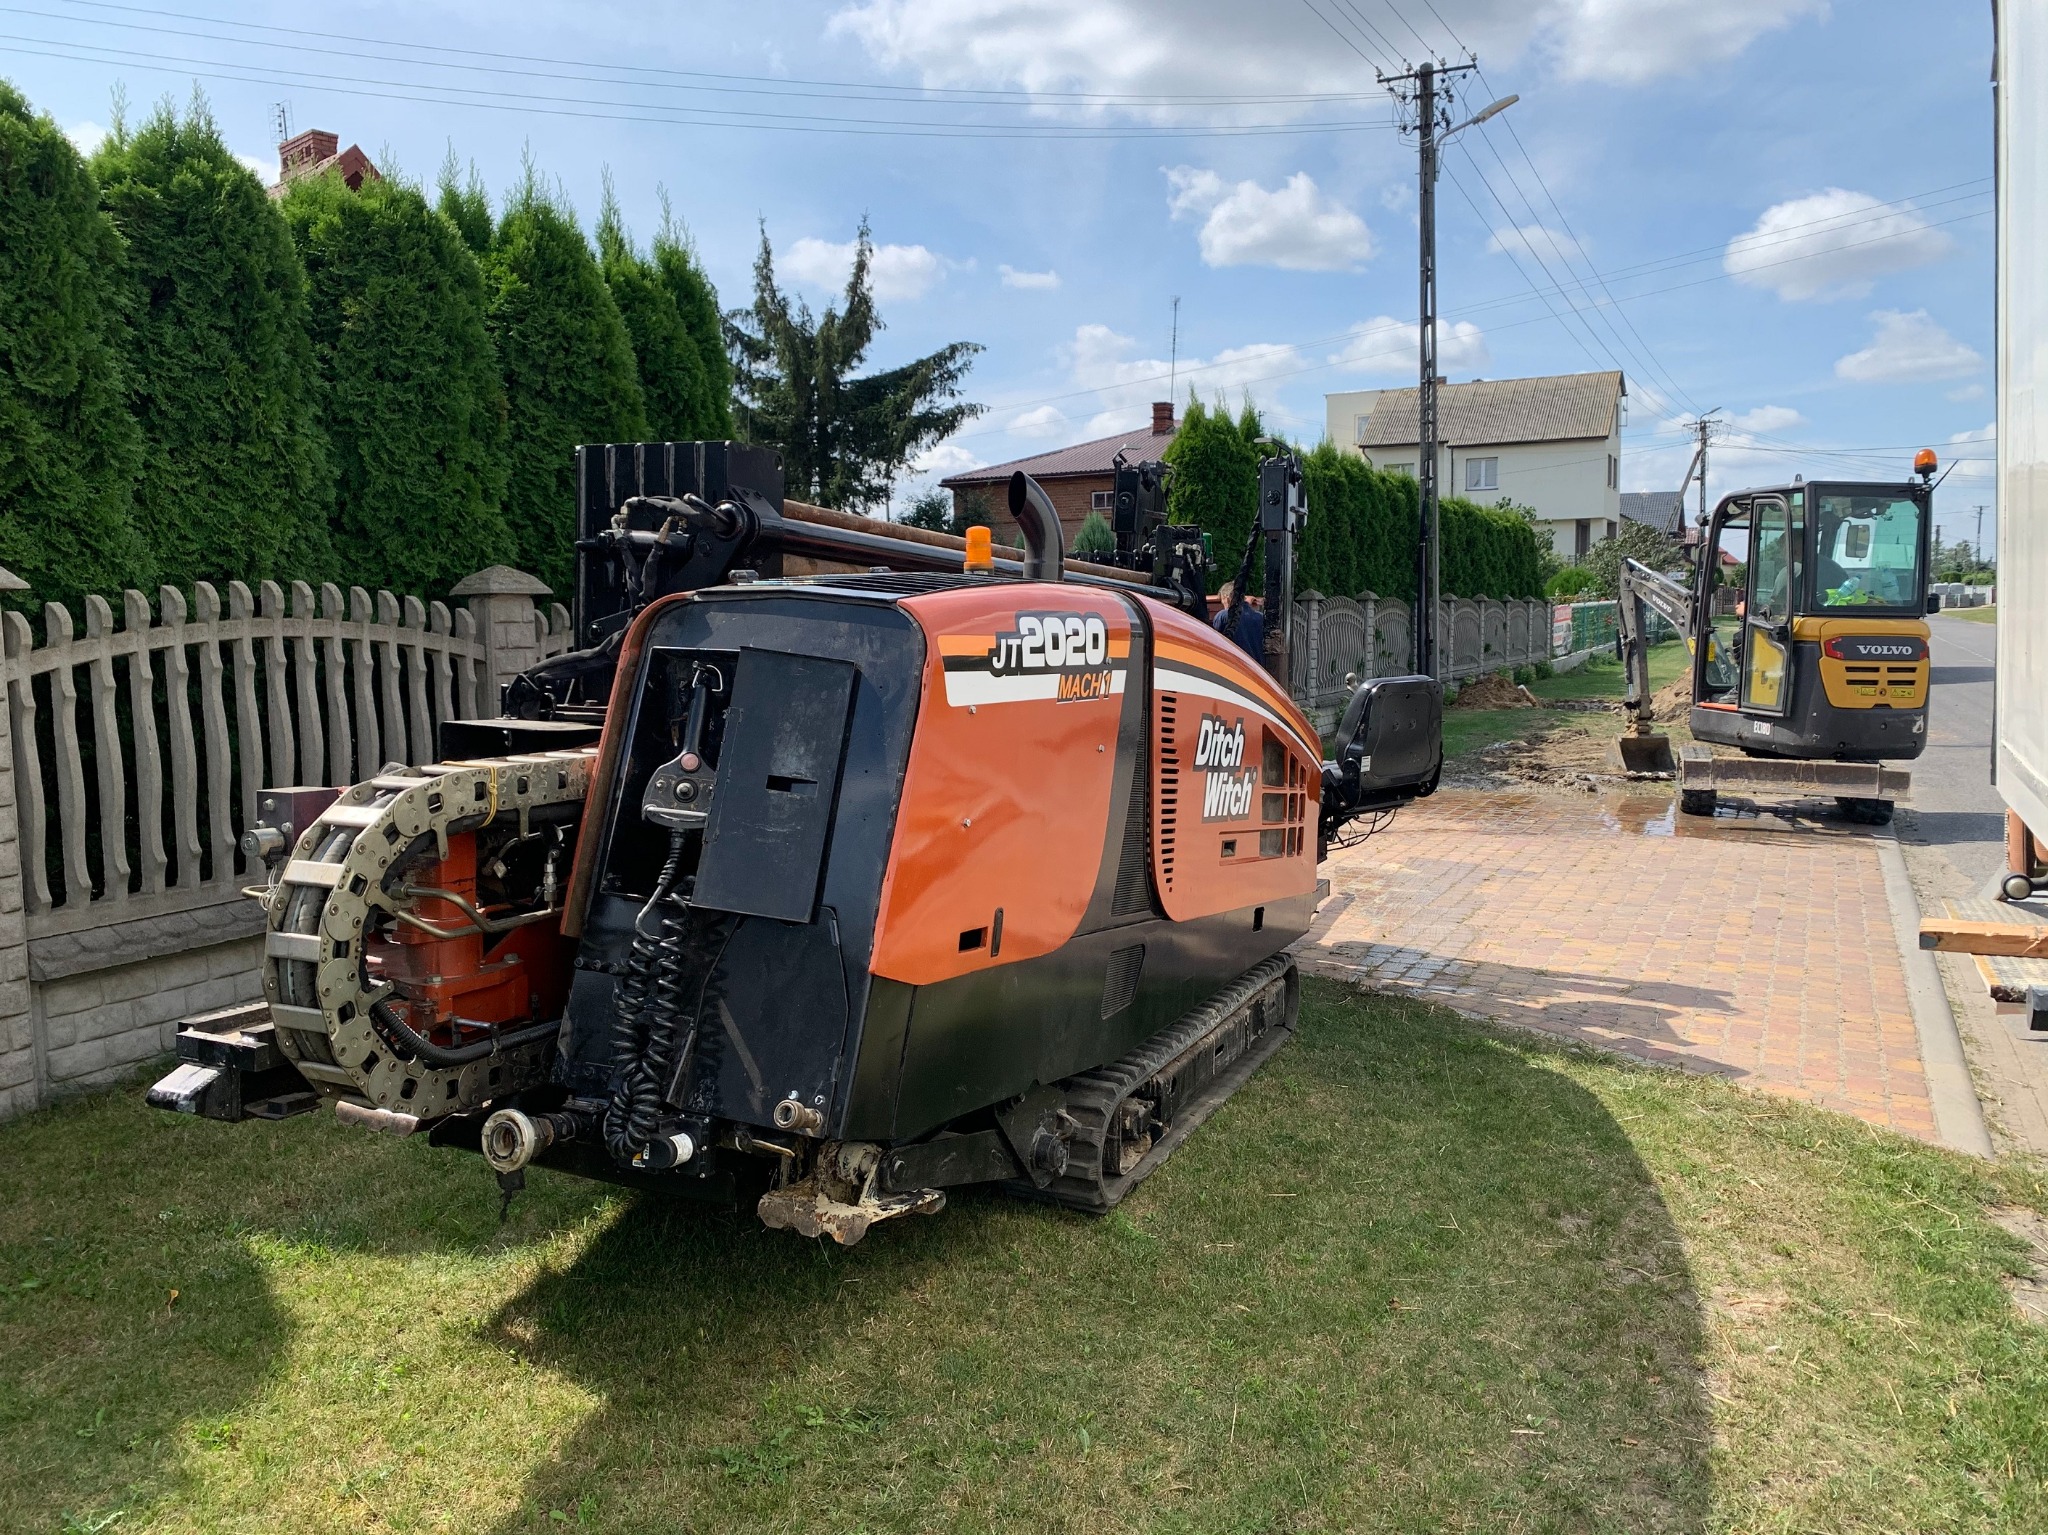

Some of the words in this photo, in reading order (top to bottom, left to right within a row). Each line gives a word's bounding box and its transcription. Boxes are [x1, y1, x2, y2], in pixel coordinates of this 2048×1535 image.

[1652, 594, 1672, 613] VOLVO
[992, 616, 1106, 669] JT2020
[1856, 645, 1913, 655] VOLVO
[1058, 672, 1103, 700] MACH
[1103, 672, 1112, 696] 1
[1195, 719, 1244, 767] Ditch
[1203, 771, 1252, 817] Witch
